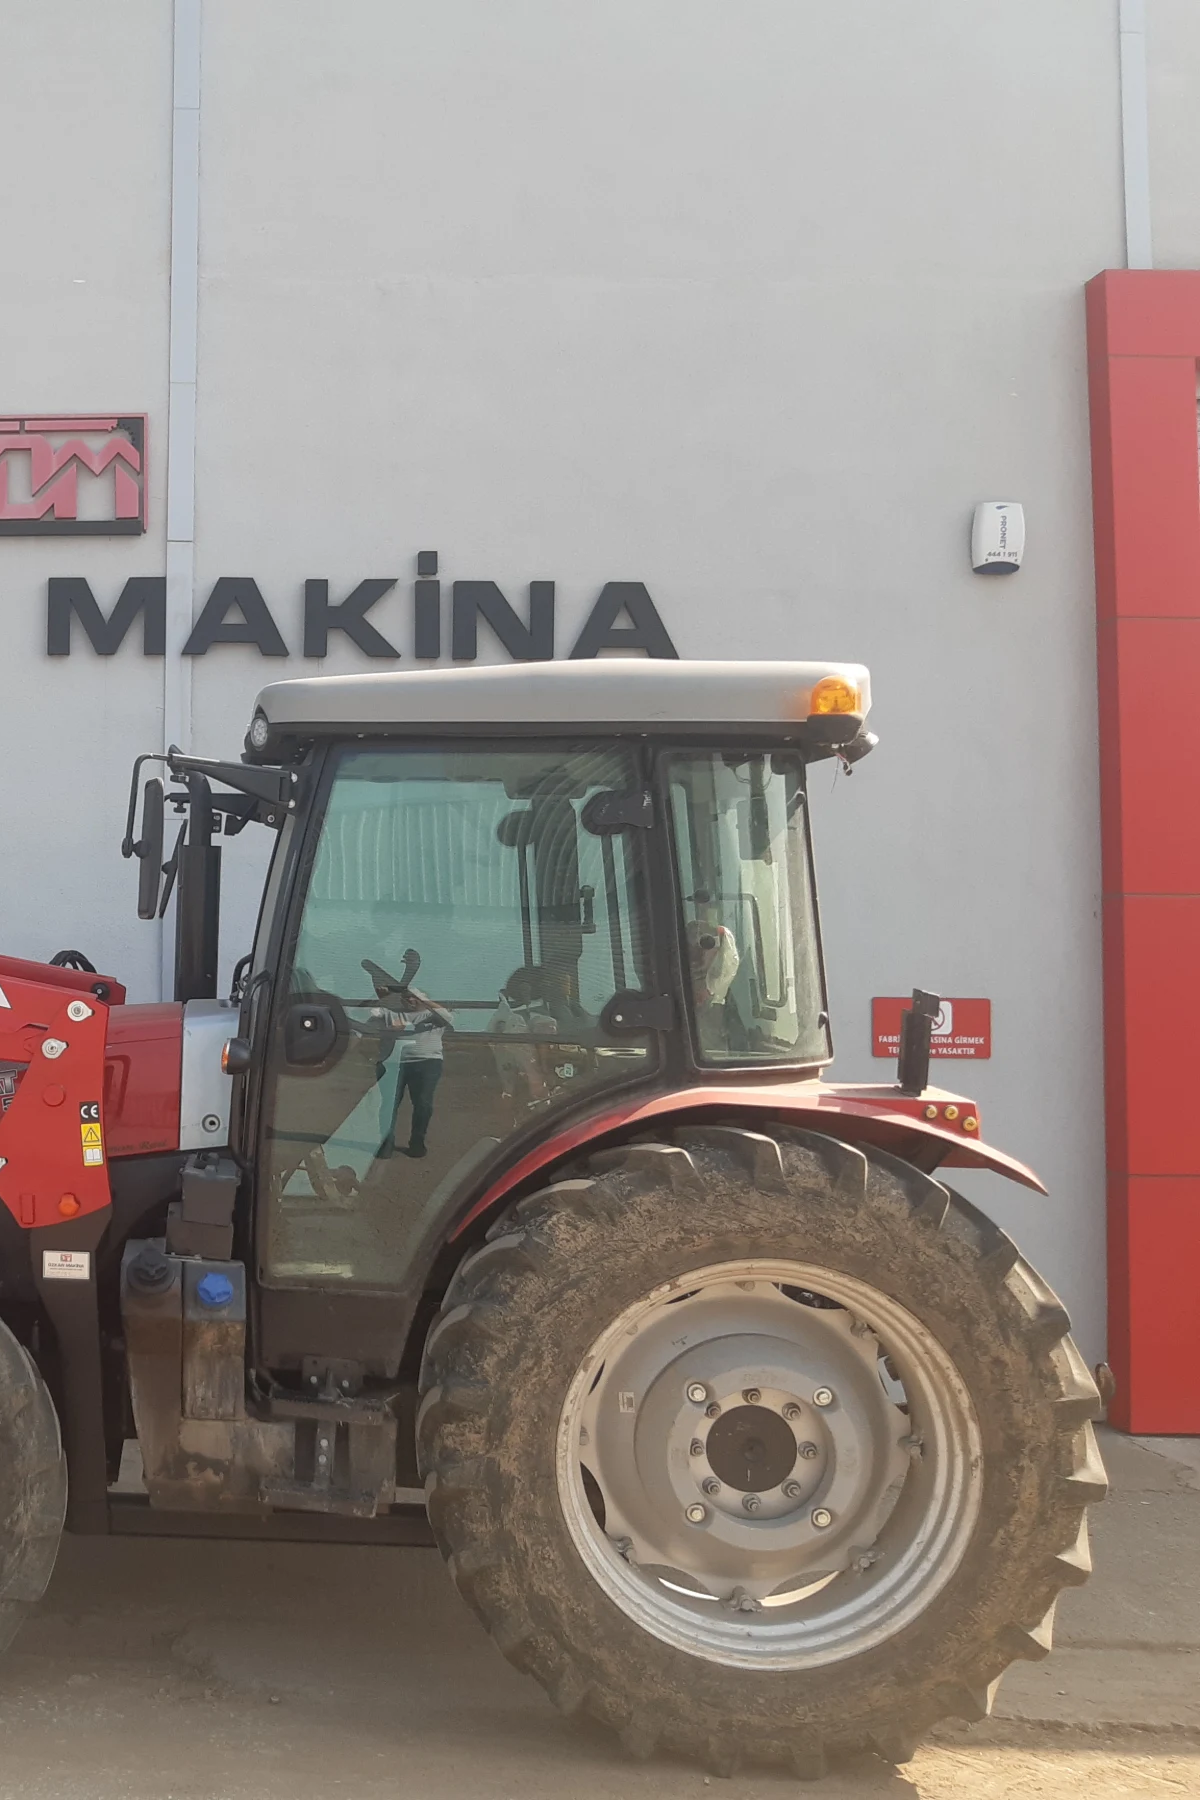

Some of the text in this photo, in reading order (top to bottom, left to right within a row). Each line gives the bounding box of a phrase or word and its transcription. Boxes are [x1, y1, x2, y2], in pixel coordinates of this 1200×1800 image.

[999, 515, 1007, 549] PRONET
[47, 551, 680, 660] MAKİNA
[878, 1035, 901, 1044] FABRİ
[954, 1036, 984, 1044] GİRMEK
[938, 1047, 975, 1055] YASAKTIR
